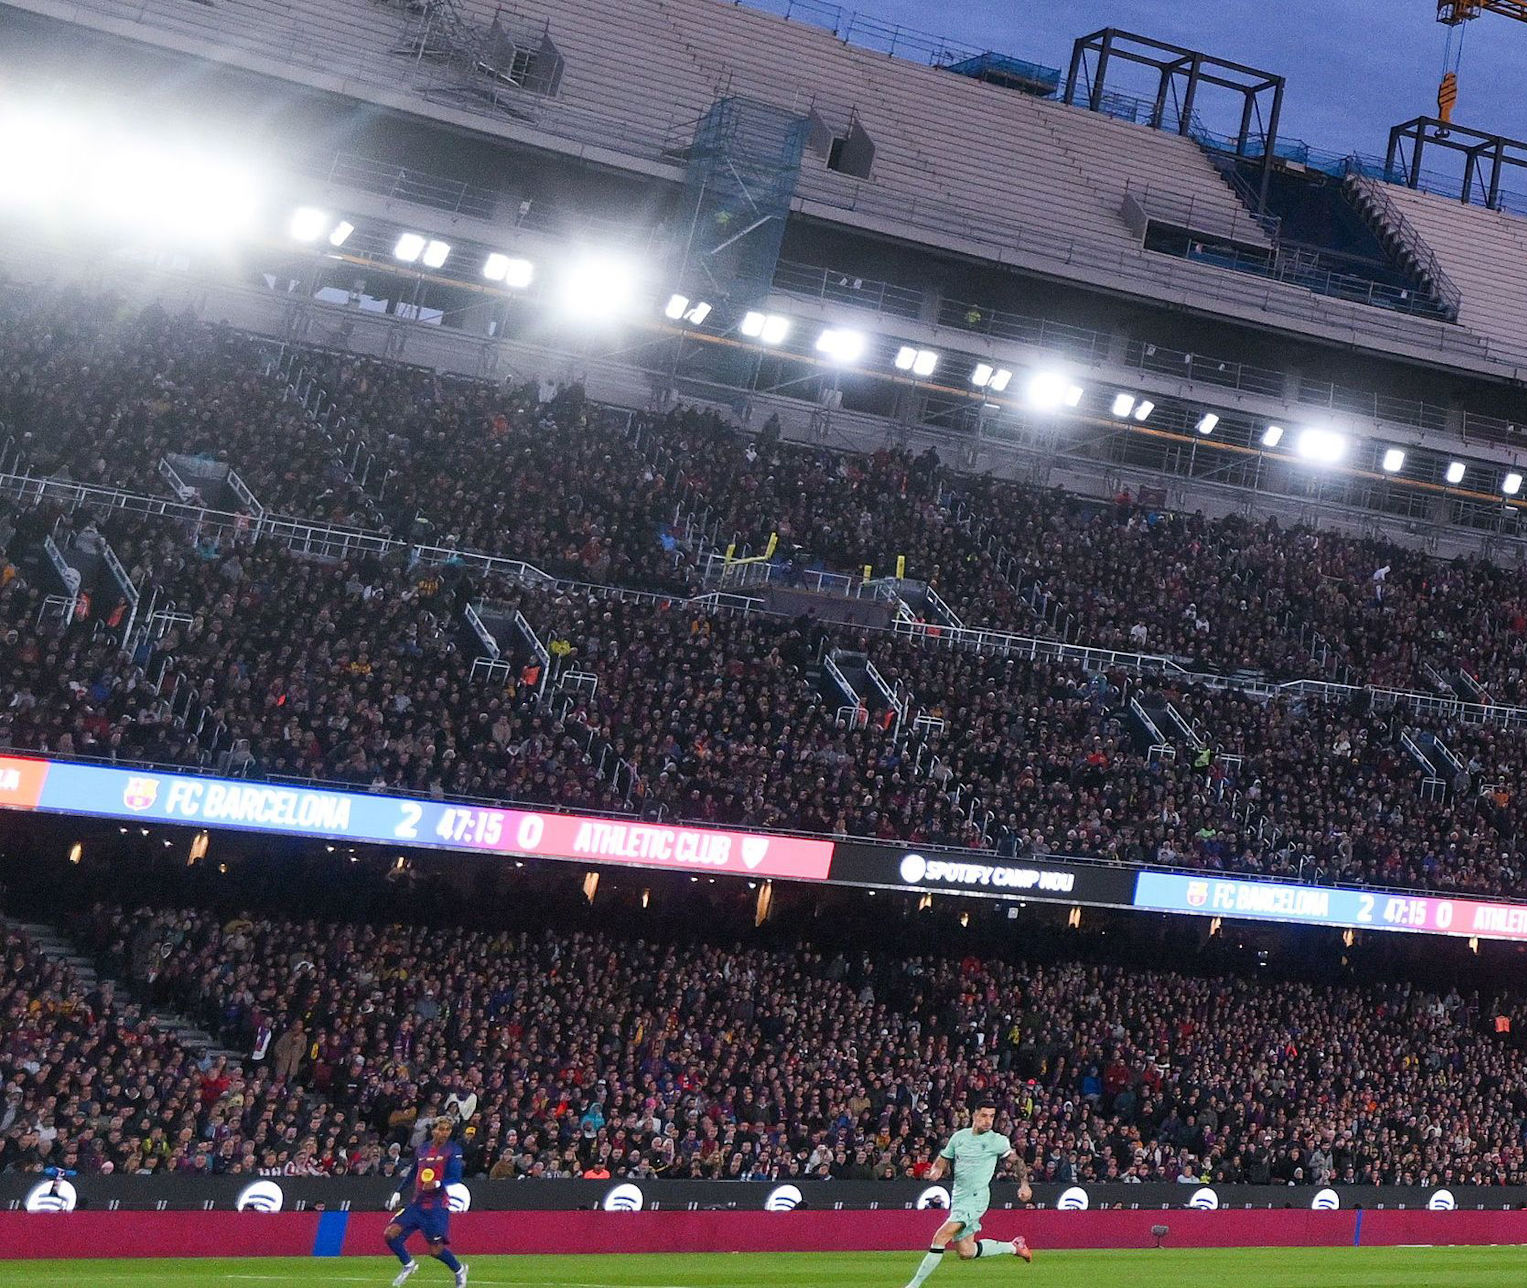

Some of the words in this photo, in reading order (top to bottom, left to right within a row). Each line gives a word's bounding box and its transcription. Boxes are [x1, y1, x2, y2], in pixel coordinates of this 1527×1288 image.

[165, 780, 203, 814] FC
[203, 787, 351, 830] BARCELONA
[394, 803, 423, 840] 2
[436, 809, 503, 845] 47:15
[517, 813, 544, 850] 0
[574, 822, 674, 861] ATHLETIC
[675, 832, 732, 865] CLUB
[925, 860, 994, 885] SPOTIFY
[993, 867, 1040, 889] CAMP
[1039, 872, 1075, 892] NOU
[1212, 882, 1236, 910] FC
[1236, 884, 1330, 917] BARCELONA
[1357, 895, 1375, 922] 2
[1383, 898, 1427, 925] 47:15
[1435, 901, 1453, 928] 0
